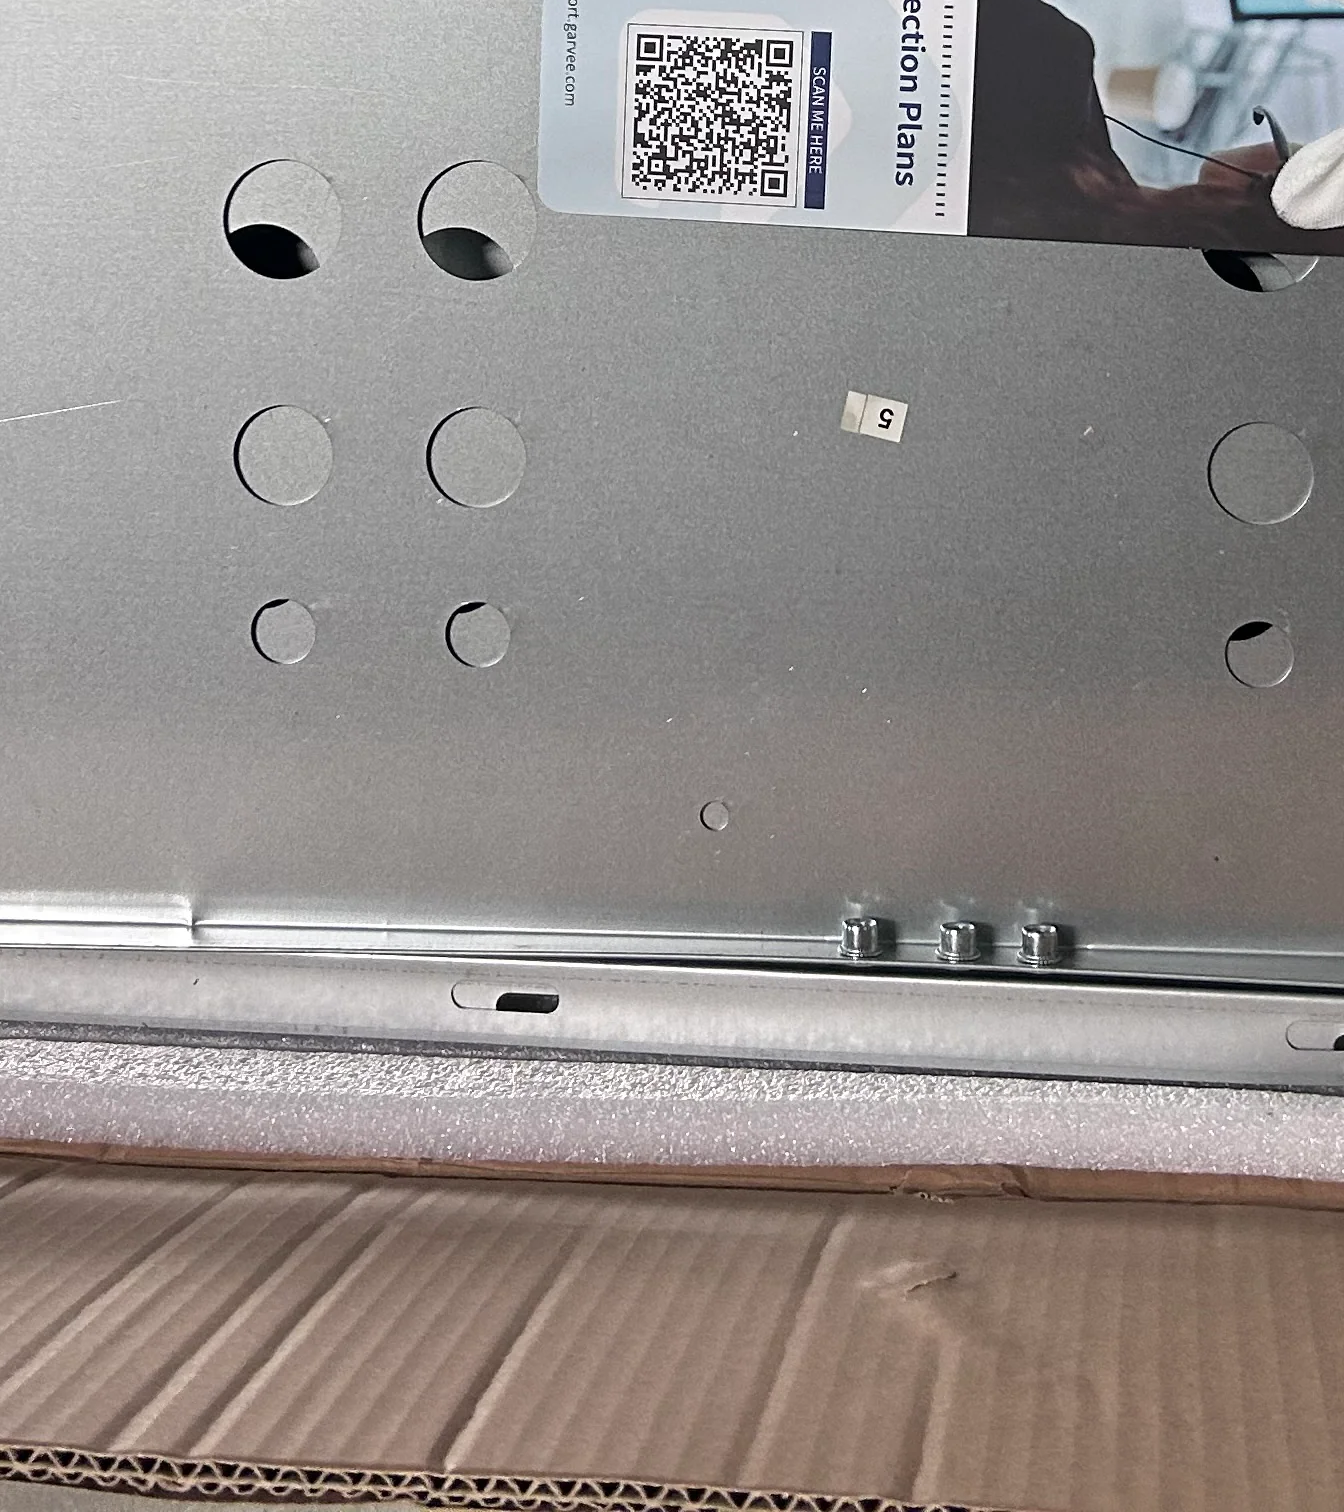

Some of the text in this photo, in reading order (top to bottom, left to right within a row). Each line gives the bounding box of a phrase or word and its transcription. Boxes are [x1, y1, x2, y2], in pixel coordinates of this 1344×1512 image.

[808, 66, 826, 174] SCAN ME HERE
[894, 102, 923, 187] Plans
[877, 408, 895, 430] 5
